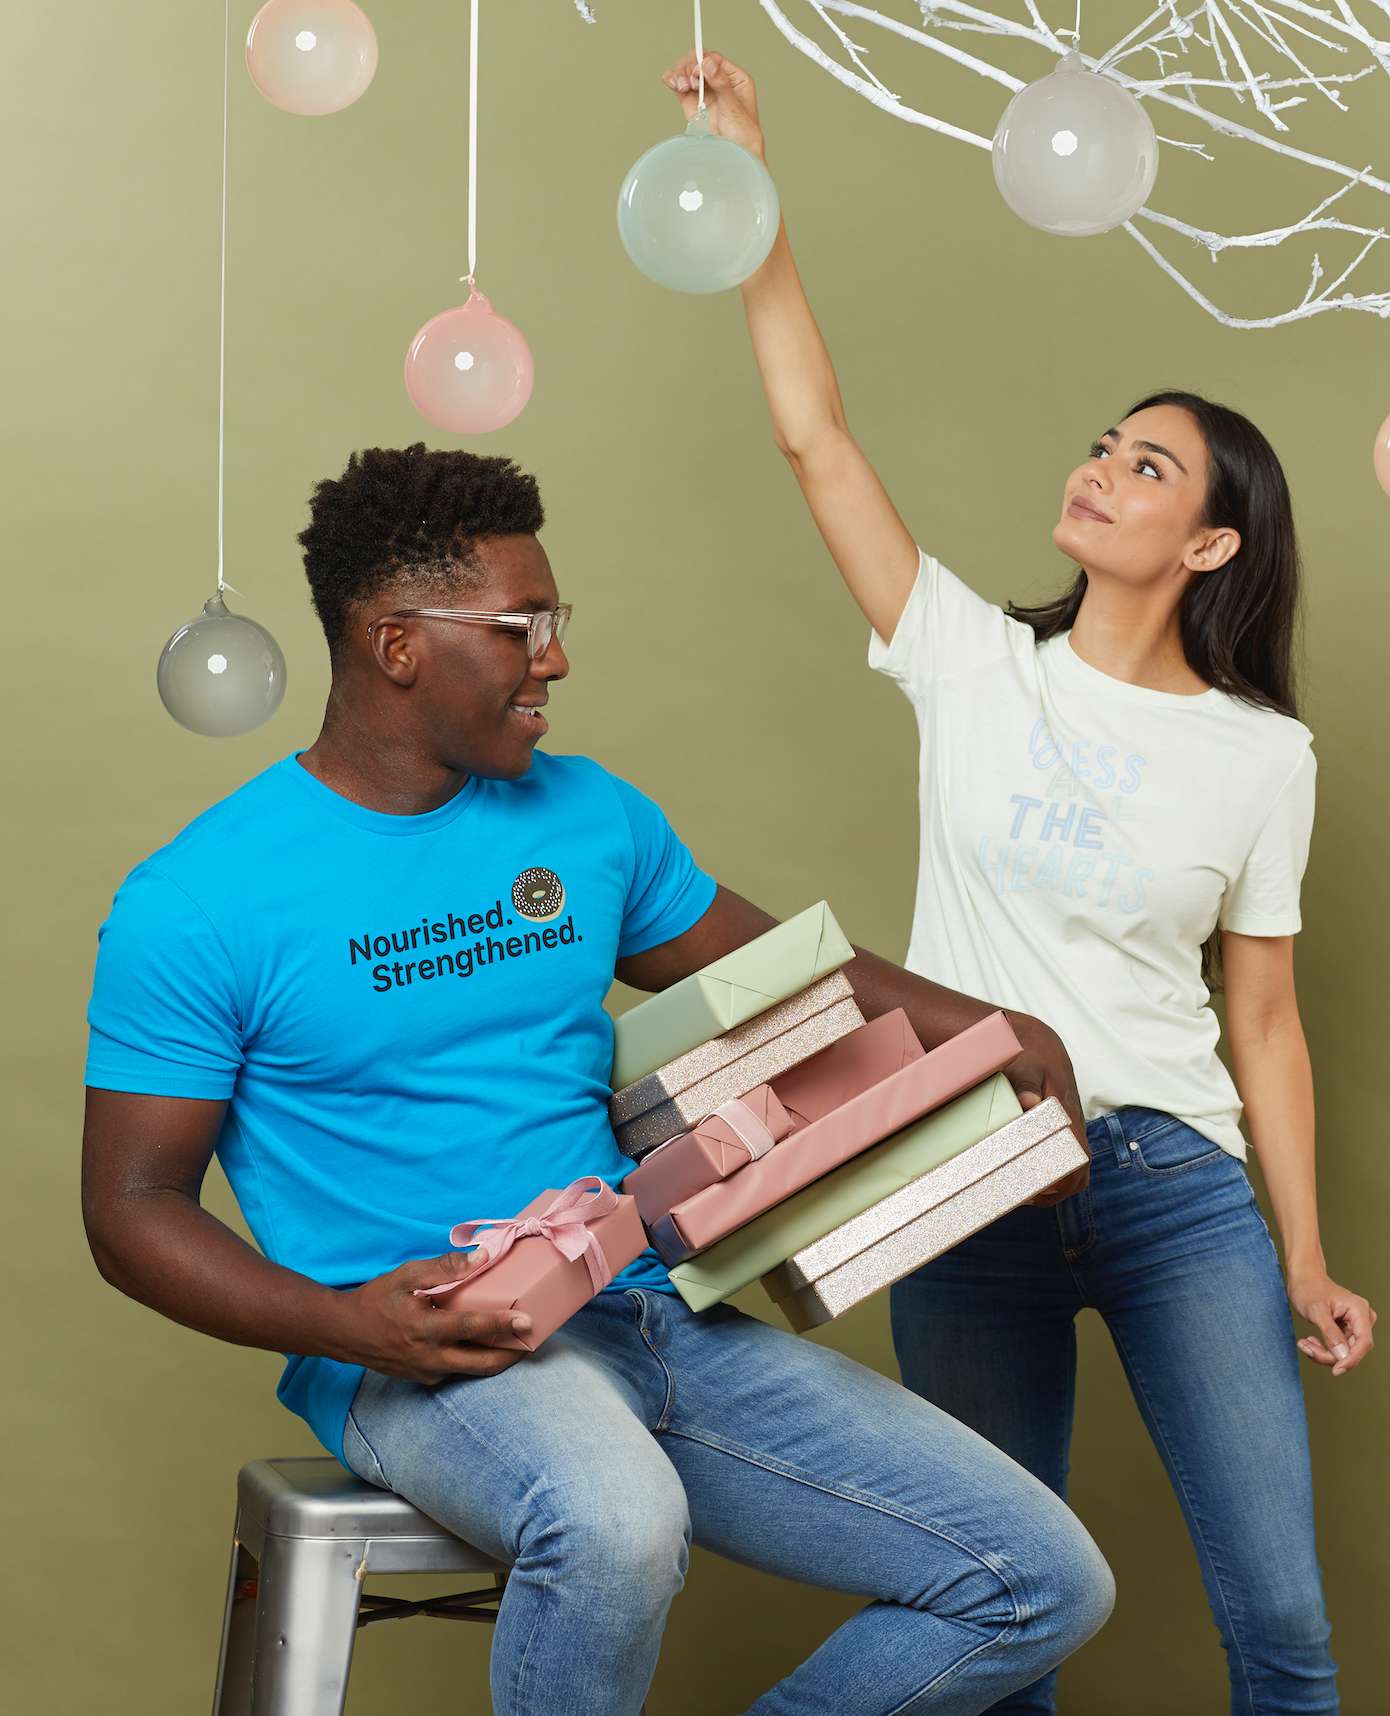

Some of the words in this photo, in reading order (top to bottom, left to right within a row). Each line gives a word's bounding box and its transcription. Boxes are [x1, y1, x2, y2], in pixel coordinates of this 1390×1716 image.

[1009, 793, 1108, 850] THE
[979, 832, 1153, 914] HEARTS
[349, 900, 513, 965] Nourished.
[372, 916, 583, 992] Strengthened.
